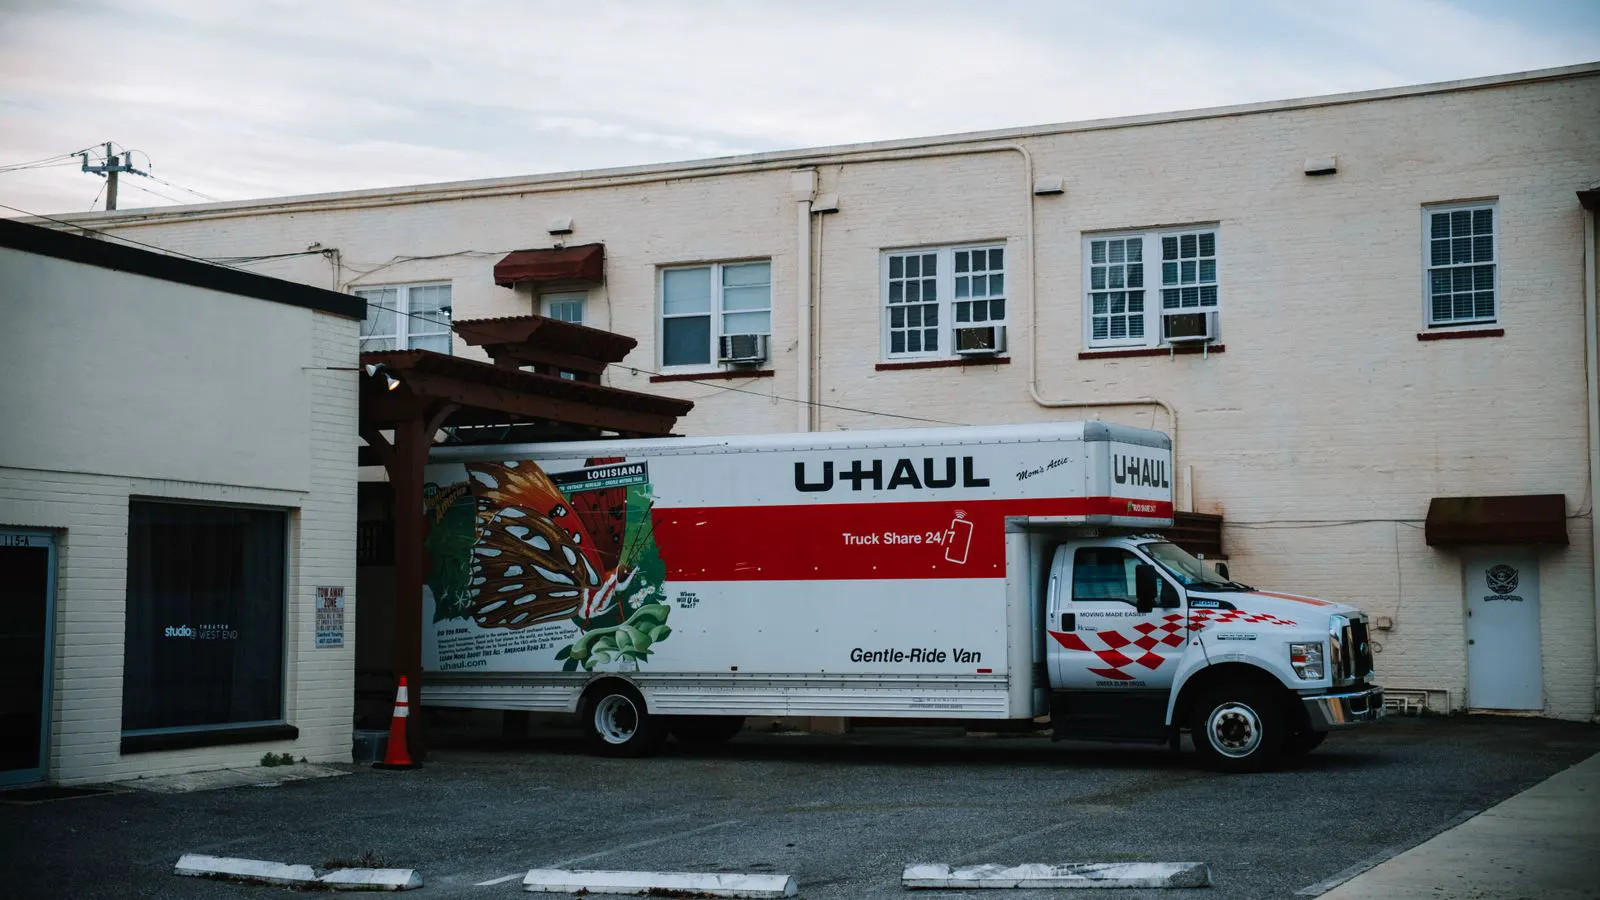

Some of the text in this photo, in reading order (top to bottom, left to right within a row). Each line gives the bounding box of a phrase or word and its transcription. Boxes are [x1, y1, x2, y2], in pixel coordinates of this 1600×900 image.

[587, 465, 643, 480] LOUISIANA
[794, 456, 990, 492] U-HAUL
[1016, 457, 1069, 481] Mom's Attic
[1114, 454, 1169, 488] U-HAUL
[842, 529, 956, 547] Truck Share 24/7
[324, 597, 337, 607] ZONE
[199, 630, 221, 640] WEST
[222, 630, 238, 640] END
[440, 659, 488, 671] uhaul.com
[850, 648, 982, 665] Gentle-Ride Van
